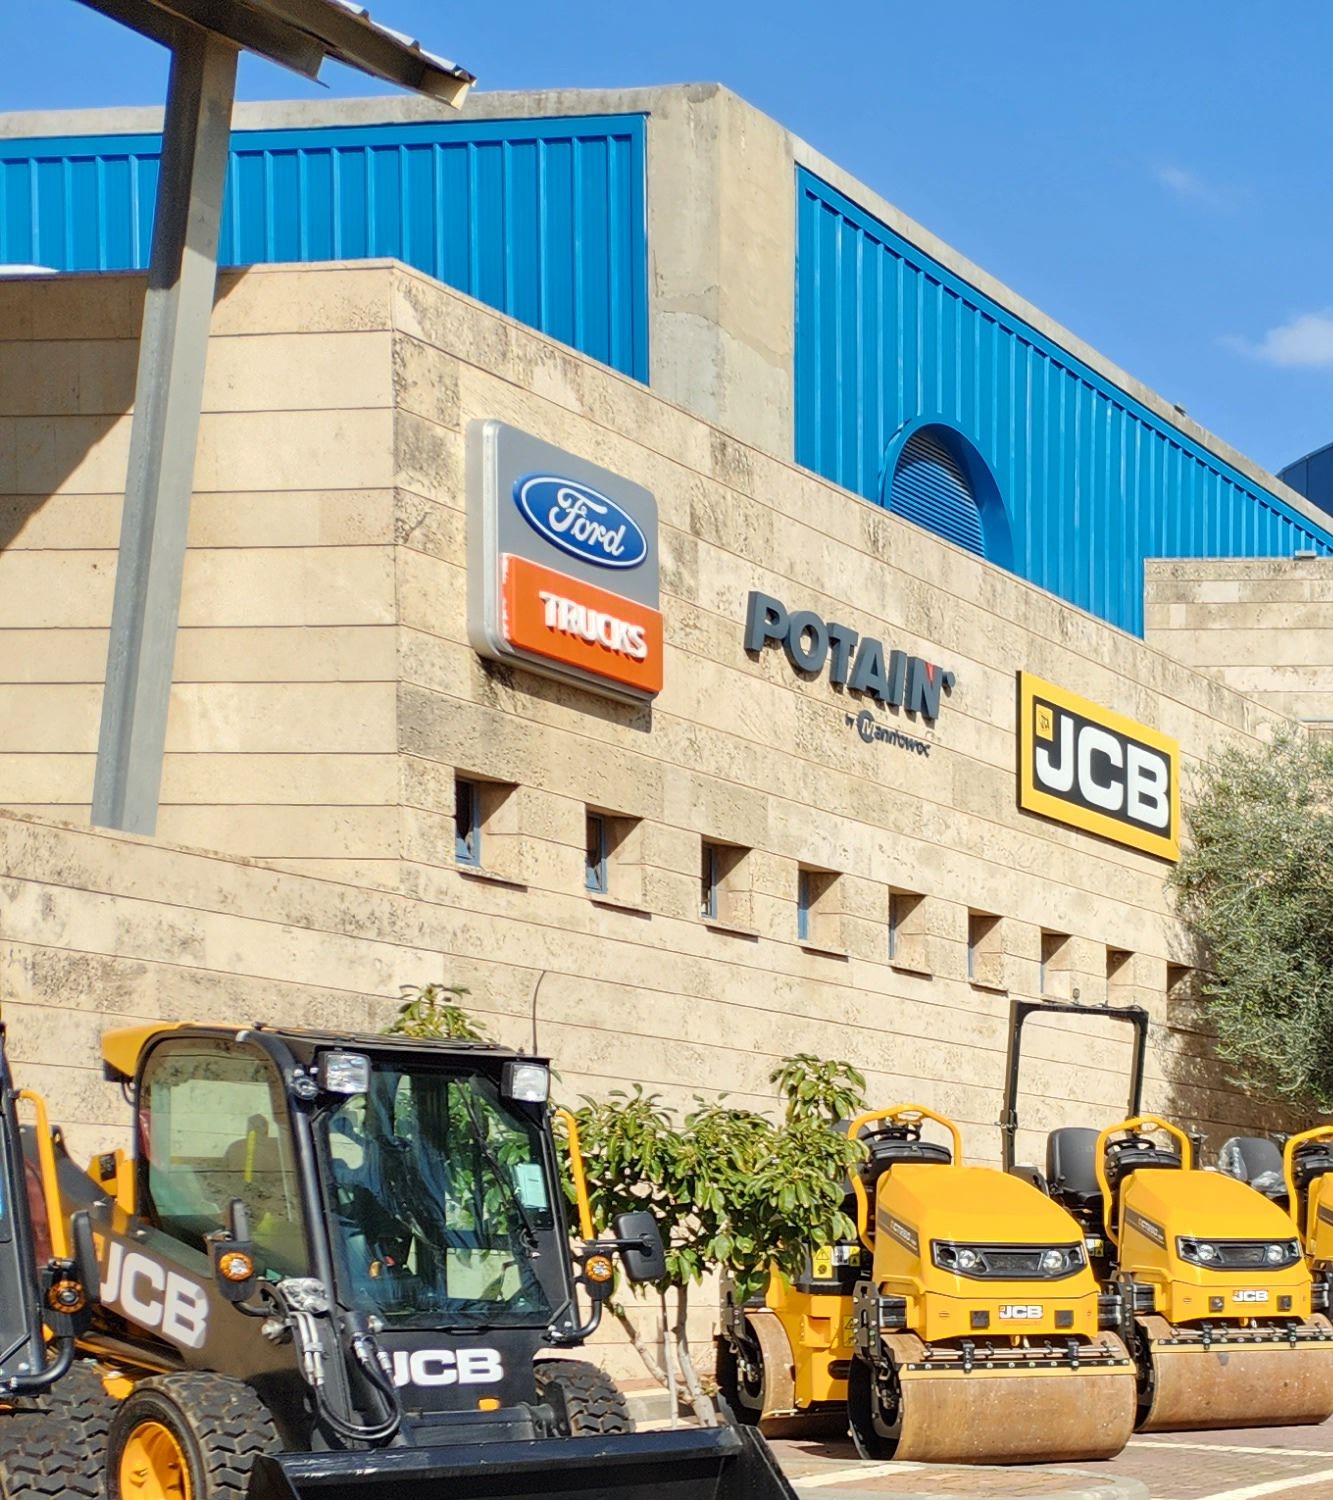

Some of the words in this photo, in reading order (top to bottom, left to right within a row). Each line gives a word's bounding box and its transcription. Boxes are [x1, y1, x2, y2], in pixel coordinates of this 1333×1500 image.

[549, 487, 627, 556] Ford
[538, 591, 648, 660] TRUCKS
[744, 590, 944, 720] POTAIN
[1035, 714, 1170, 830] JCB
[100, 1241, 209, 1349] JCB
[1000, 1305, 1043, 1319] JCB
[1231, 1290, 1269, 1302] JCB
[392, 1348, 505, 1389] JCB
